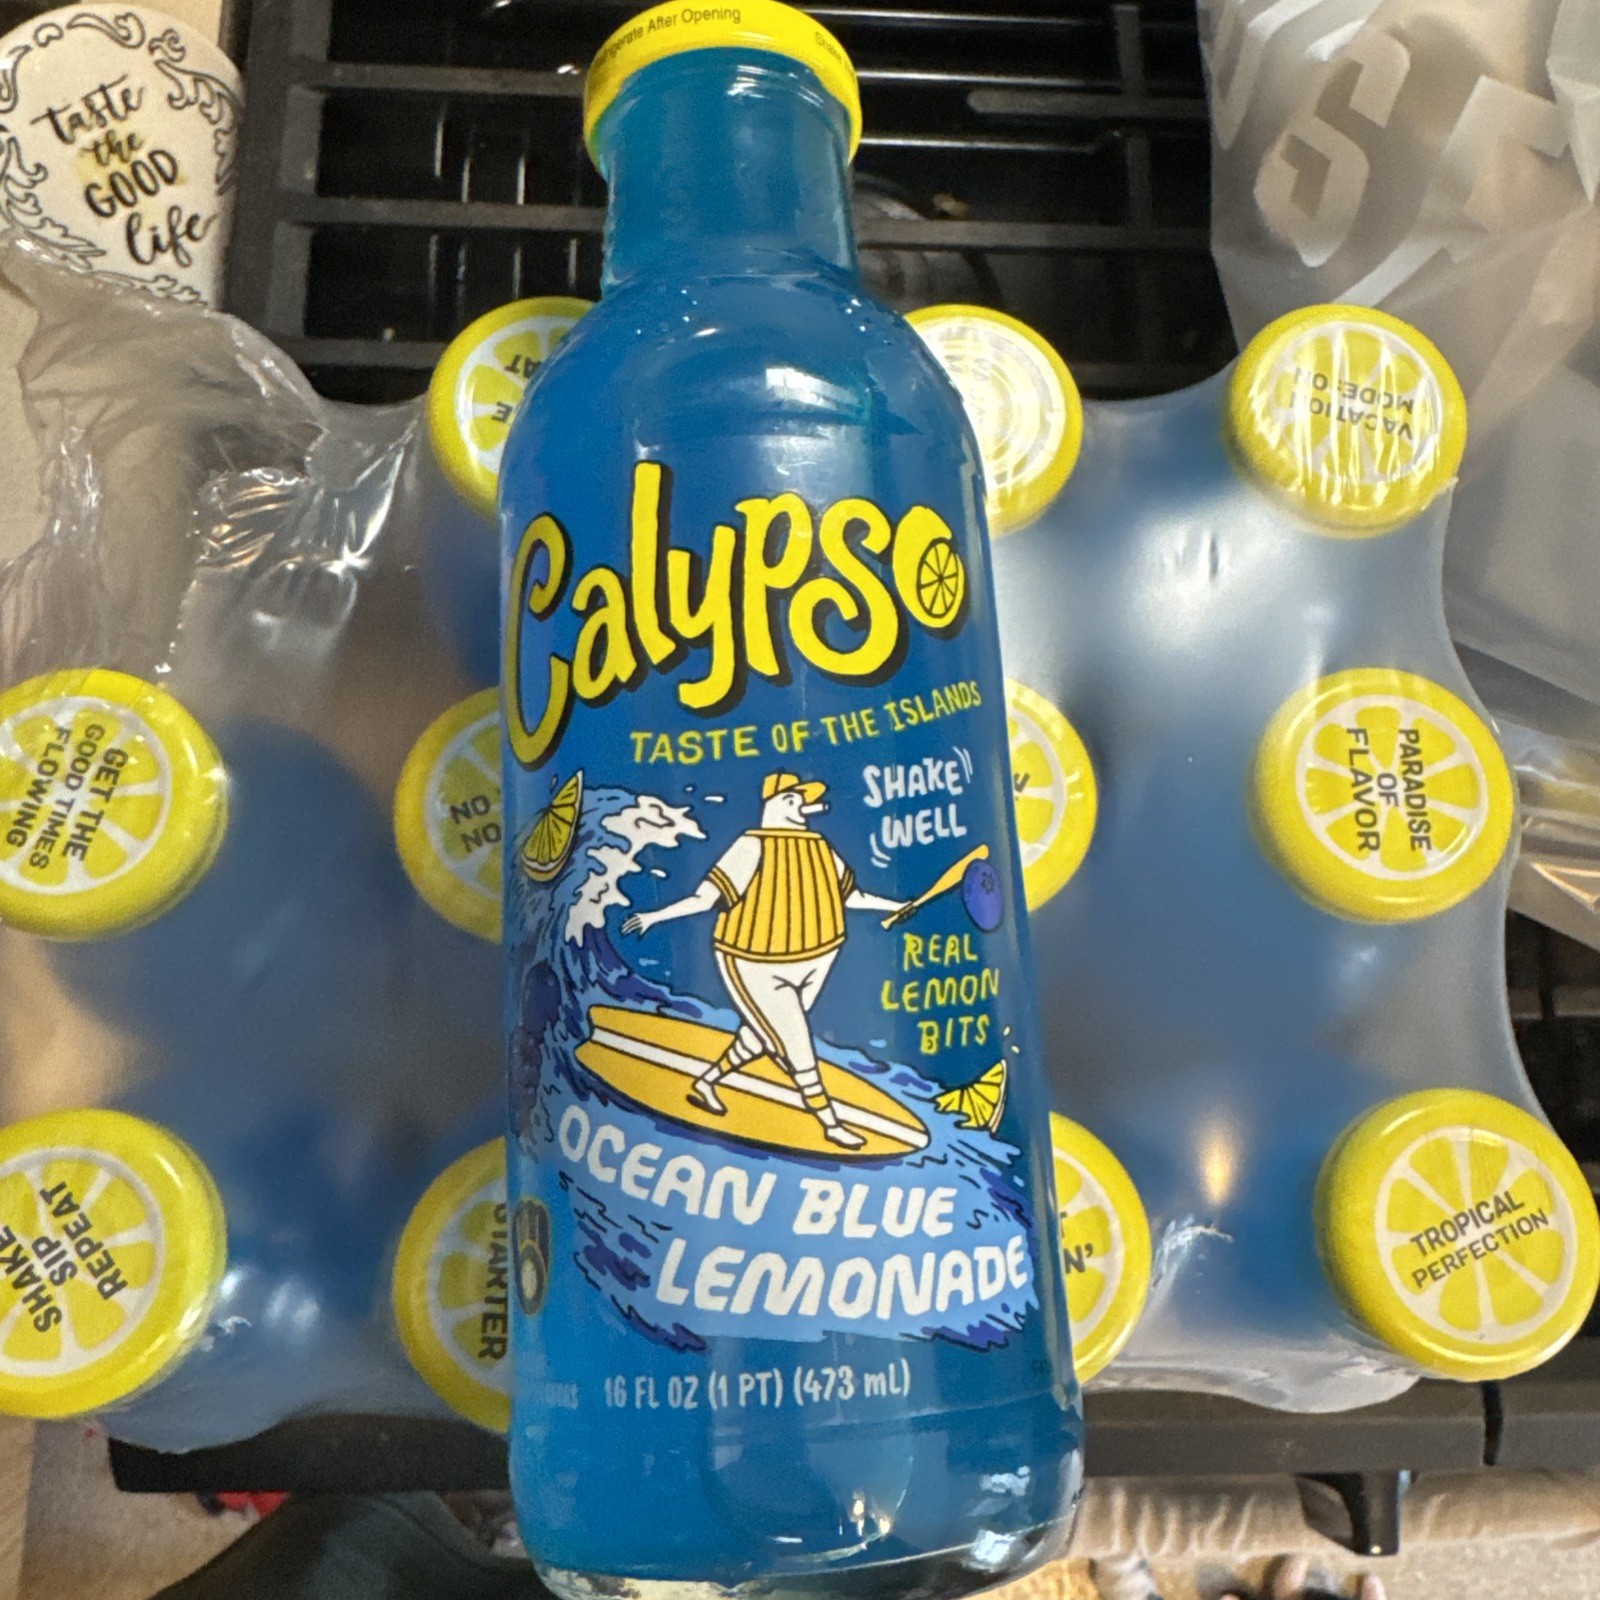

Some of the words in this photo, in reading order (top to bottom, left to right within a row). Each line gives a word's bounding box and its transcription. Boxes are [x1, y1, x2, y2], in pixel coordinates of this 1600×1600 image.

[647, 15, 678, 33] After
[681, 8, 741, 25] Opening
[31, 74, 145, 145] taste
[81, 130, 145, 167] the
[85, 150, 178, 218] GOOD
[126, 206, 217, 267] life
[505, 461, 968, 766] Calypso
[629, 726, 761, 765] TASTE
[771, 721, 810, 754] OF
[820, 708, 881, 746] THE
[883, 681, 983, 732] ISLANDS
[6, 726, 72, 848] FLOWING
[64, 723, 106, 791] GOOD
[89, 747, 129, 803] GET
[862, 757, 963, 808] SHAKE
[450, 794, 491, 825] NO
[1346, 727, 1381, 852] FLAVOR
[1376, 772, 1399, 808] OF
[1398, 729, 1433, 852] PARADISE
[29, 797, 76, 870] TIMES
[61, 810, 105, 861] THE
[460, 823, 502, 852] NO
[881, 803, 967, 849] WELL
[903, 933, 978, 972] REAL
[880, 968, 1000, 1012] LEMON
[917, 1014, 990, 1055] BITS
[557, 1104, 778, 1226] OCEAN
[791, 1177, 958, 1238] BLUE
[39, 1181, 128, 1300] REPEAT
[1409, 1190, 1525, 1257] TROPICAL
[1411, 1208, 1550, 1289] PERFECTION
[0, 1225, 62, 1332] SHAKE
[31, 1236, 78, 1287] SIP
[655, 1234, 1029, 1320] LEMONADE
[604, 1374, 628, 1409] 16
[635, 1375, 660, 1410] FL
[667, 1375, 699, 1411] OZ
[708, 1369, 728, 1411] (1
[738, 1367, 784, 1408] PT)
[793, 1364, 855, 1407] (473
[863, 1357, 911, 1398] mL)
